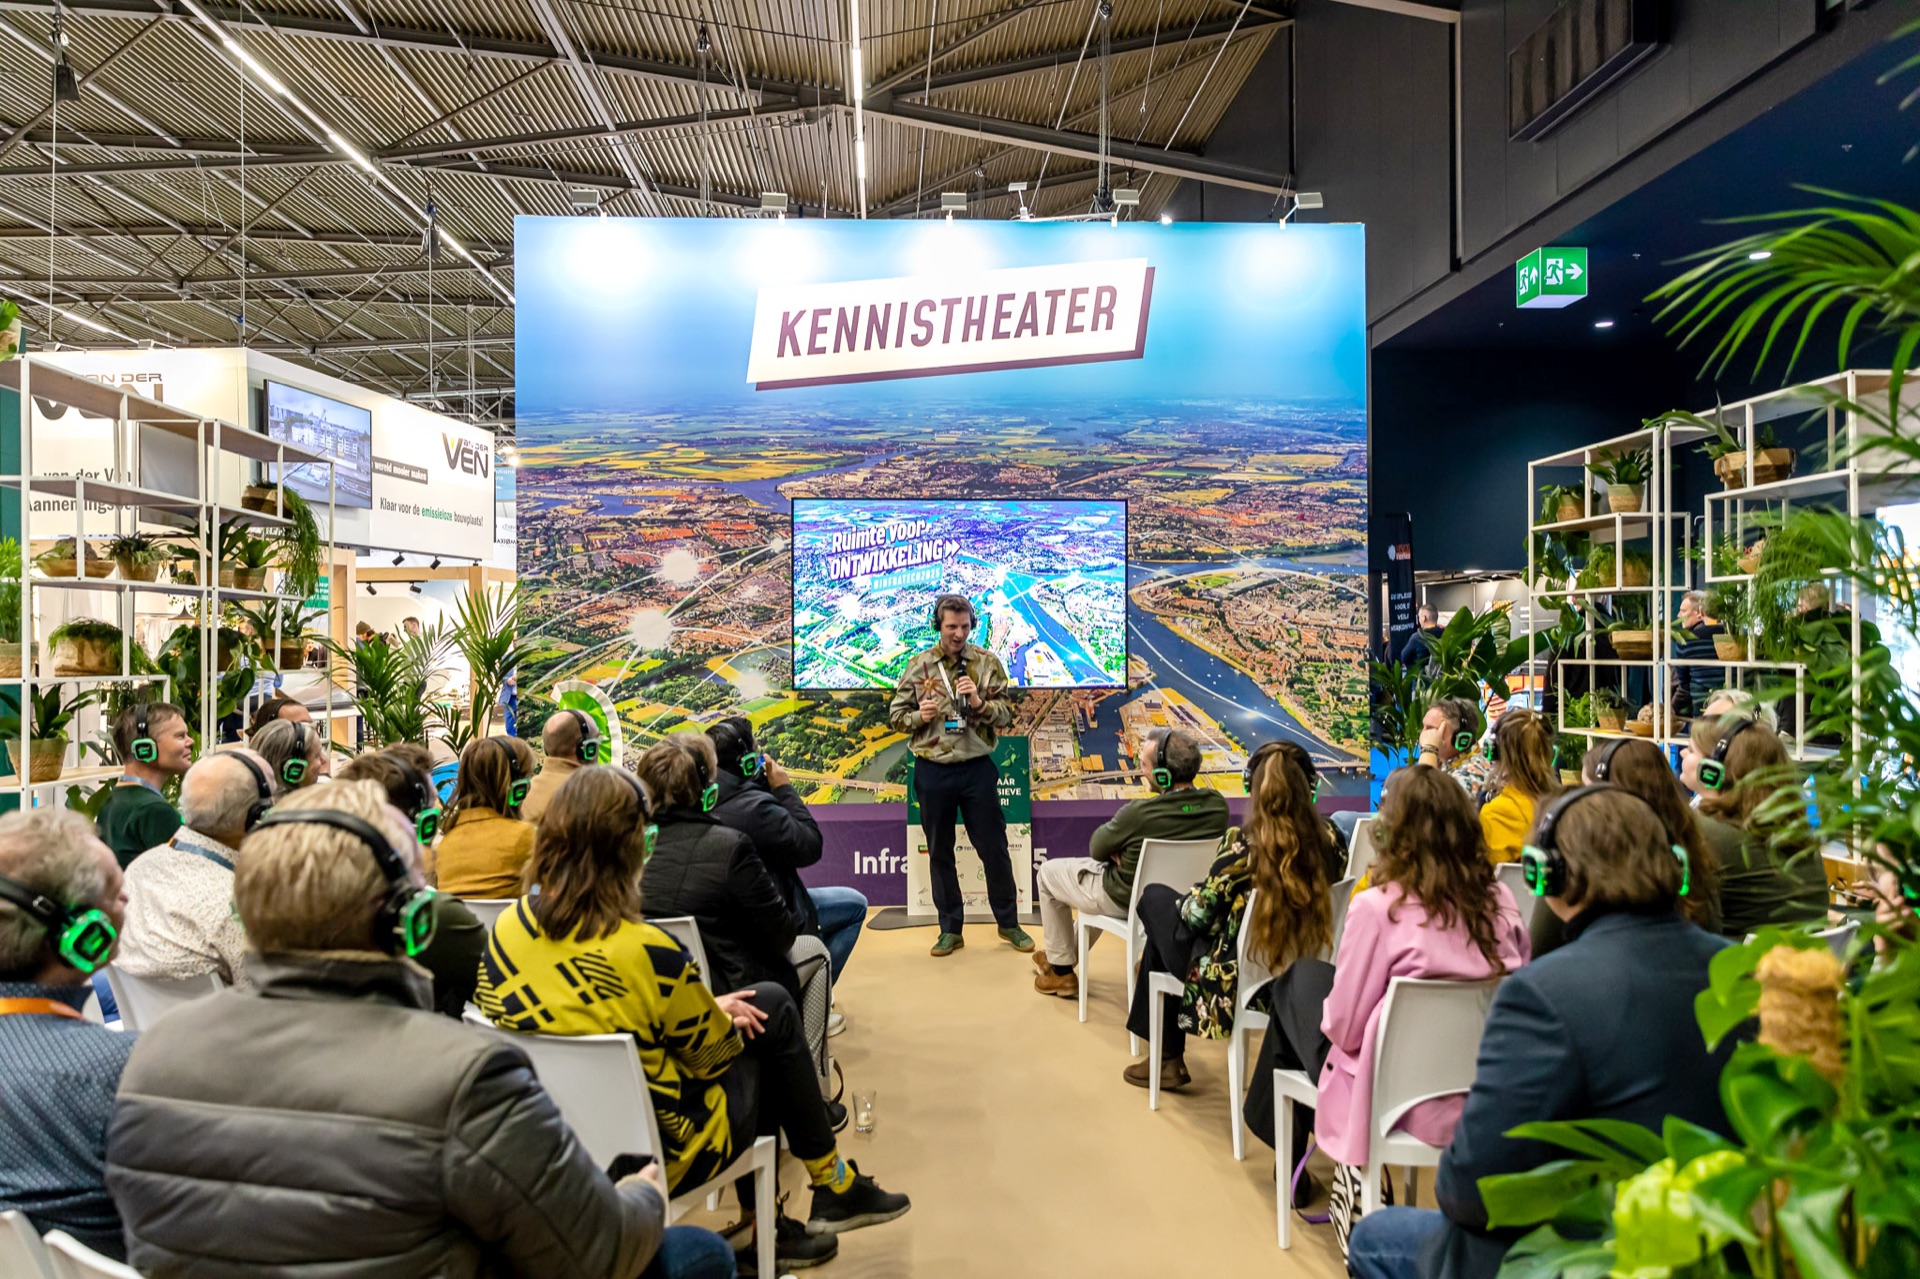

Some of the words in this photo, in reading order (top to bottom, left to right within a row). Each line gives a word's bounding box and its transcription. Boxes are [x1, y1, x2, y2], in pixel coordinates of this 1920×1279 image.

[777, 285, 1118, 358] KENNISTHEATER
[121, 373, 163, 383] DER
[442, 432, 488, 479] VEN
[380, 497, 397, 512] Klaar
[398, 502, 411, 515] voor
[412, 504, 420, 517] de
[453, 511, 484, 528] bouwplaats!
[832, 526, 887, 553] Ruimte
[888, 520, 926, 543] voor
[829, 538, 944, 580] ONTWIKKELING
